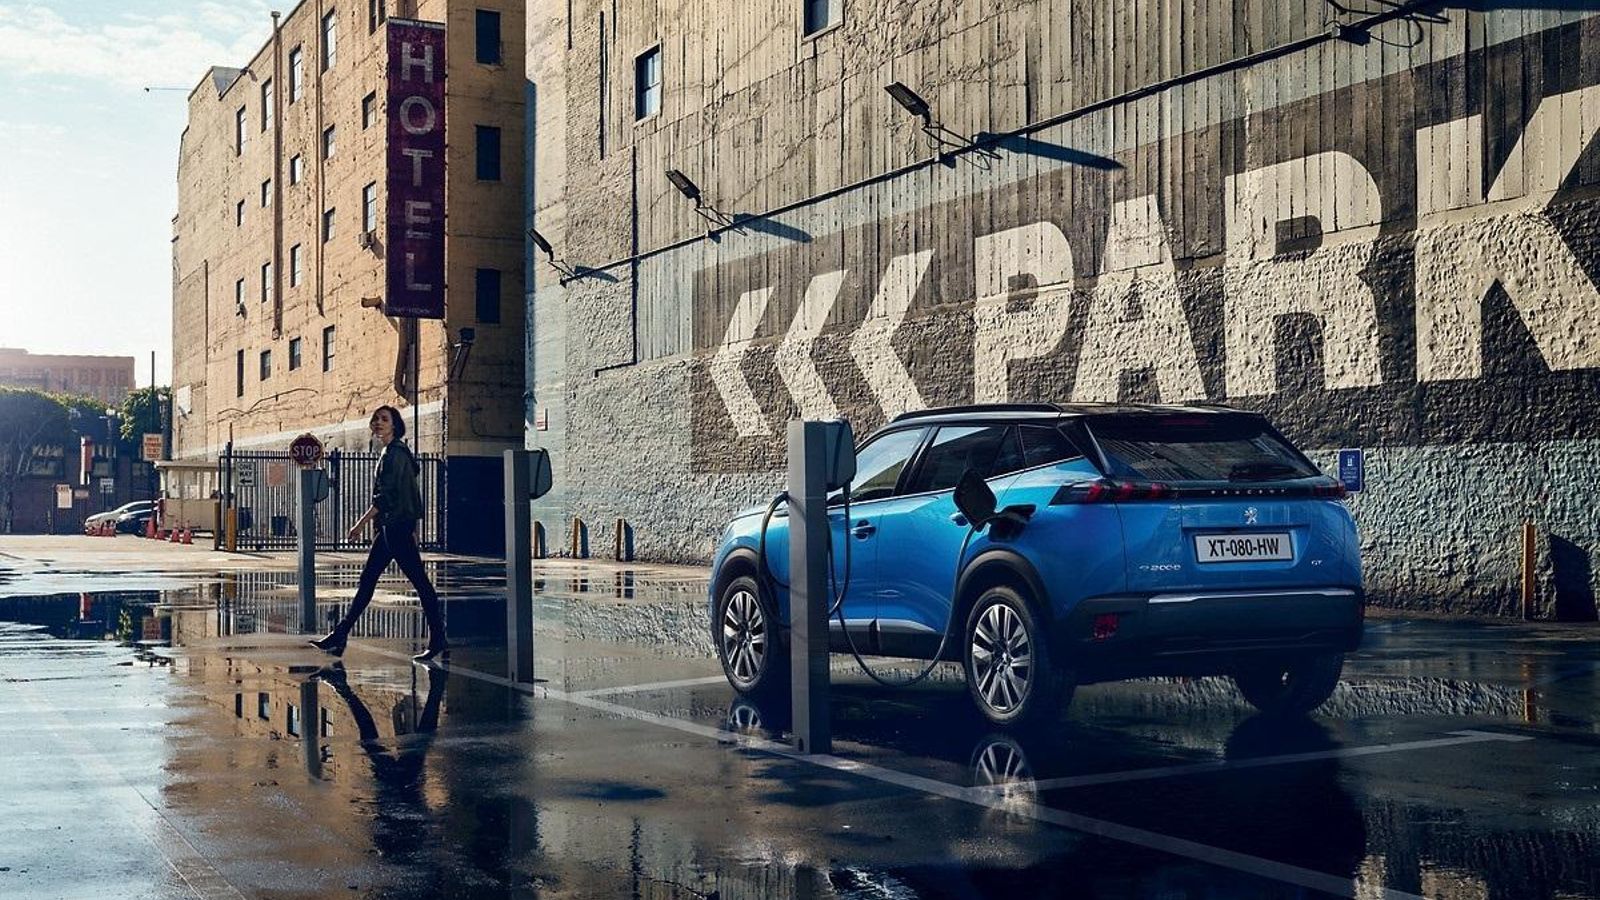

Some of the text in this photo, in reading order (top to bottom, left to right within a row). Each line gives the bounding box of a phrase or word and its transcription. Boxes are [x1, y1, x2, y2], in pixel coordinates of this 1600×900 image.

[400, 42, 436, 291] HOTEL
[974, 85, 1600, 404] PARK
[293, 445, 320, 458] STOP
[1208, 537, 1279, 558] XT-080-HW
